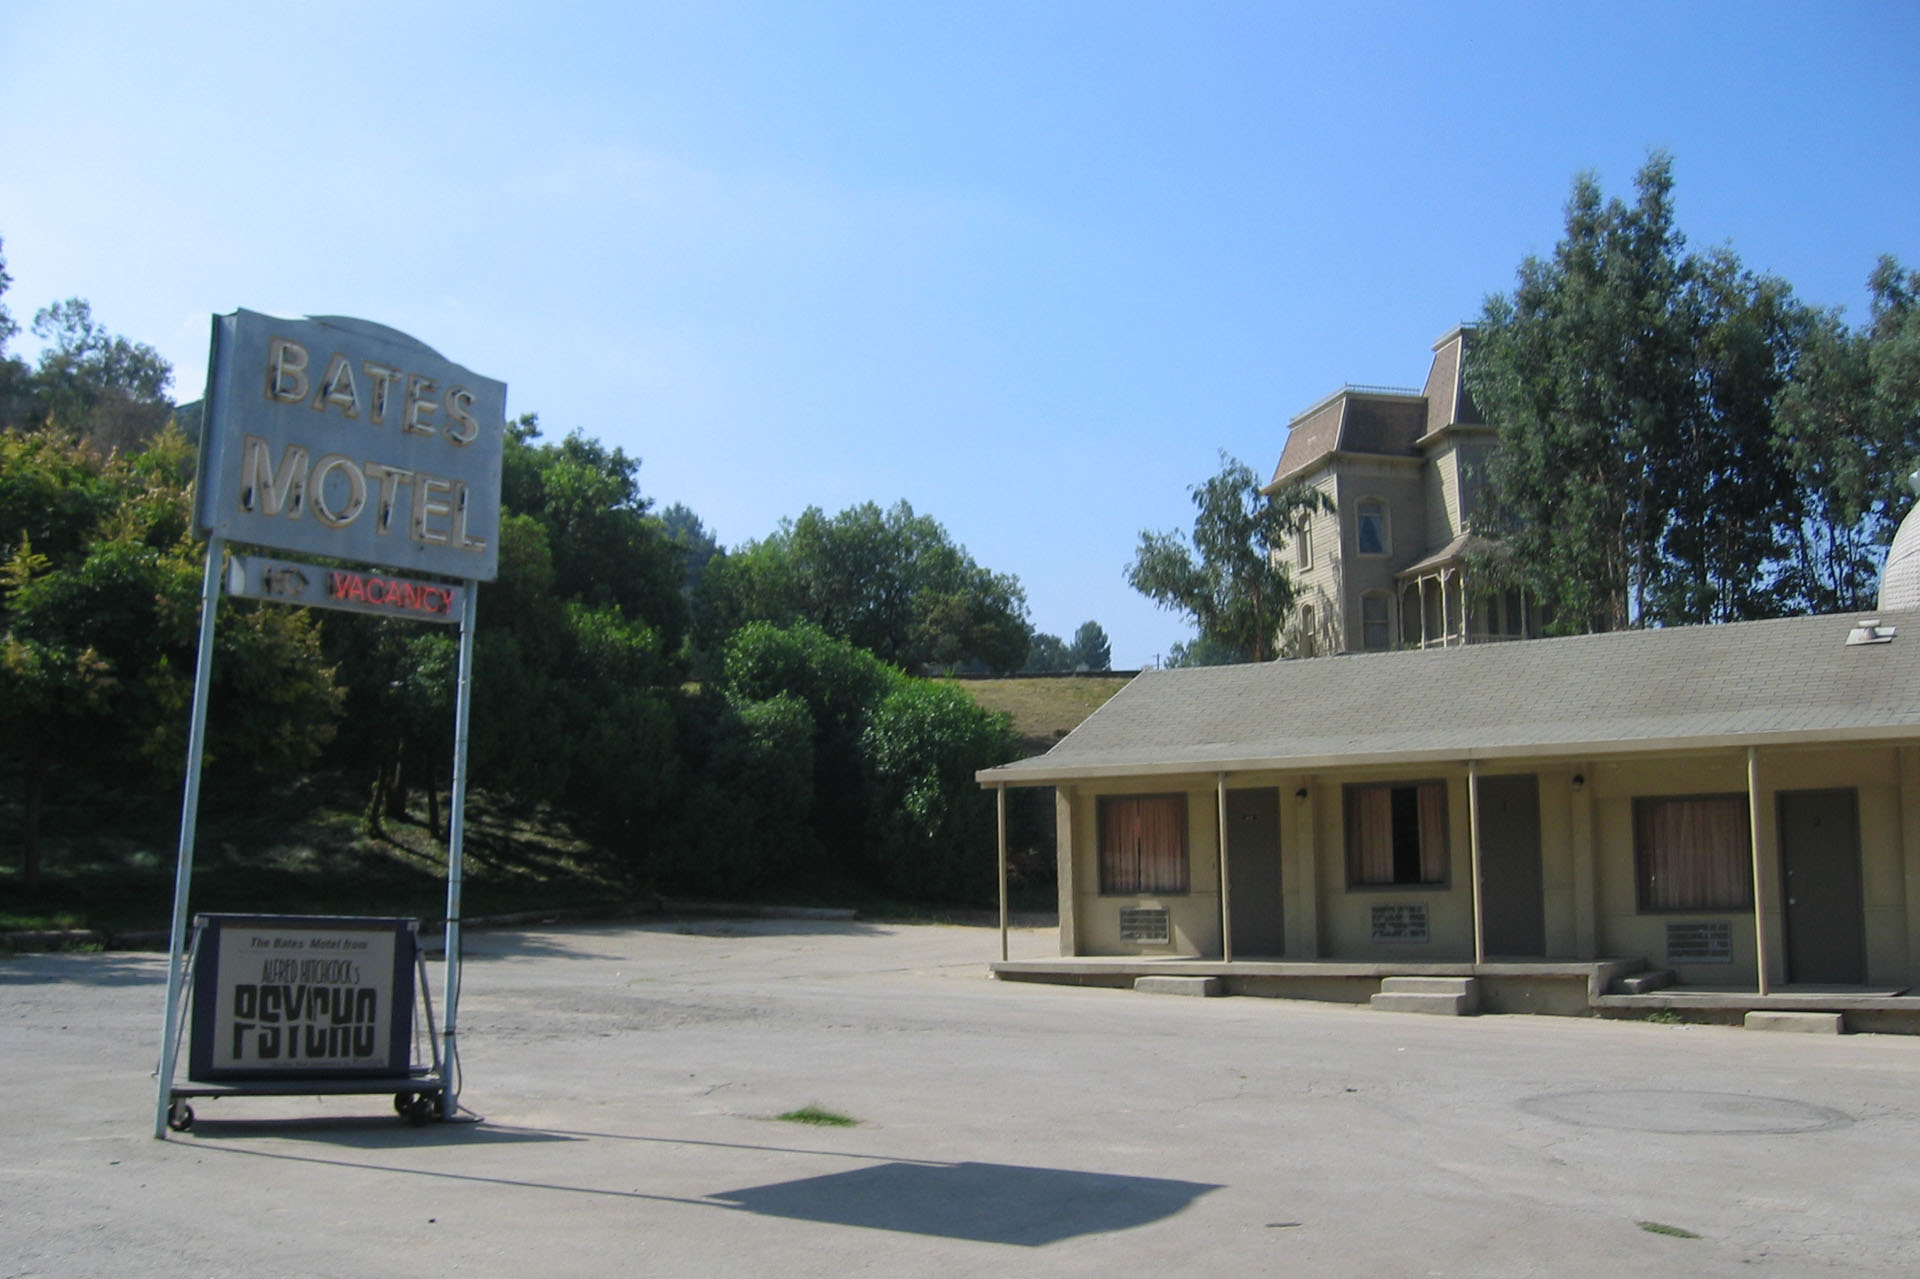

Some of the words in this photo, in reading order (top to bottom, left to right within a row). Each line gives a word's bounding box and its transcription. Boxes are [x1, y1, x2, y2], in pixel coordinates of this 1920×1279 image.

[265, 336, 479, 447] BATES
[238, 435, 487, 551] MOTEL
[331, 571, 456, 614] VACANCY
[251, 937, 270, 949] The
[273, 937, 303, 949] Bates
[309, 938, 341, 950] Motel
[343, 939, 368, 950] from
[261, 959, 298, 983] ALFRED
[232, 984, 377, 1060] PSYCHO
